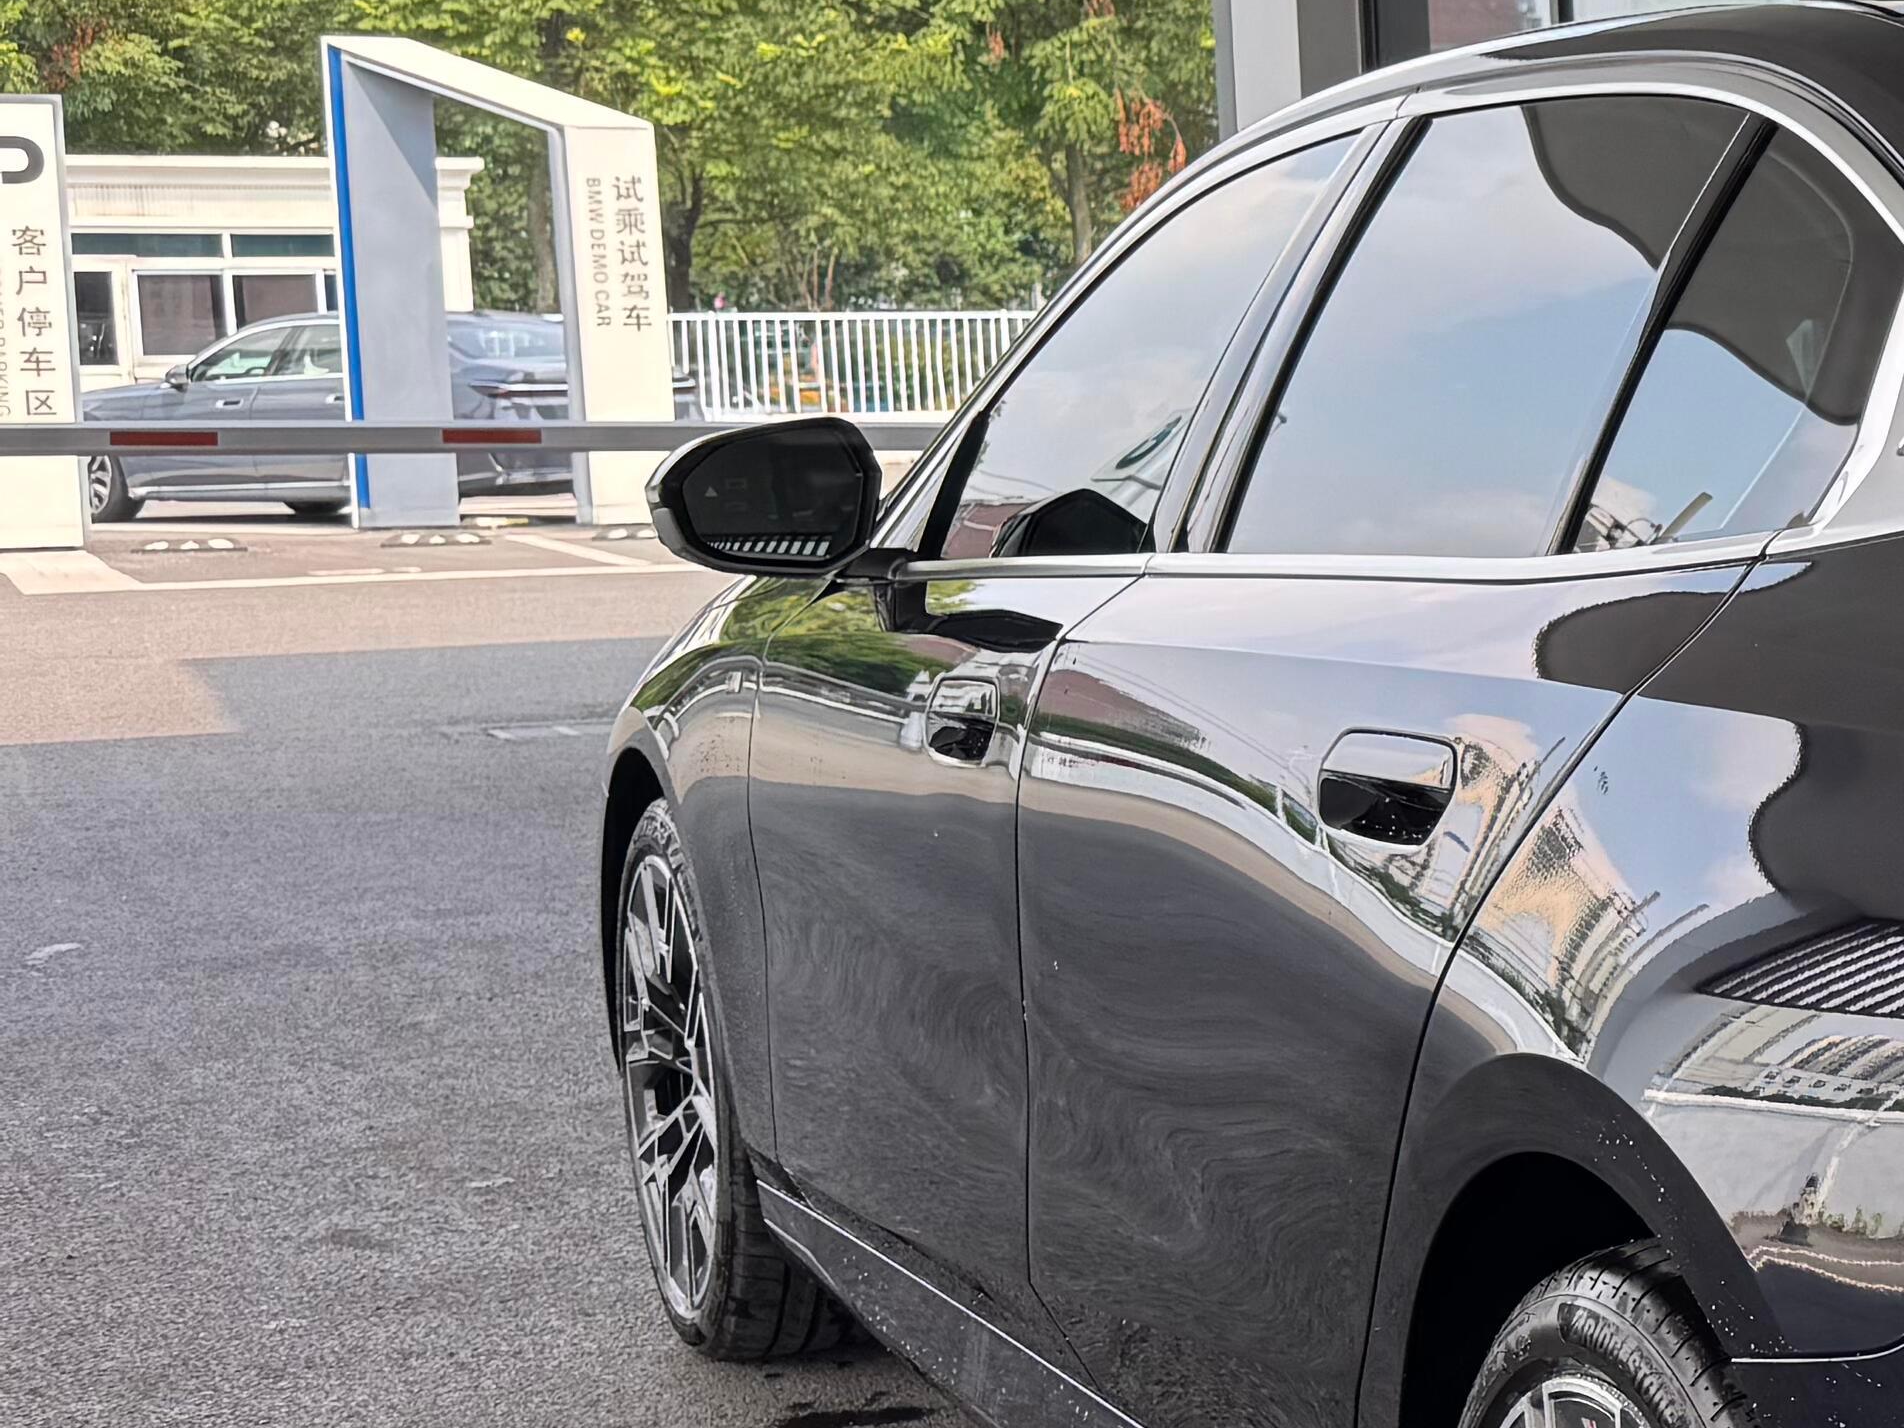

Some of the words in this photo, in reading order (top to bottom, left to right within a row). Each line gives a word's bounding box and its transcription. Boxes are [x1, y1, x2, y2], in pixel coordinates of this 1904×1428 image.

[585, 177, 605, 224] BMW
[590, 229, 609, 284] DEMO
[612, 175, 652, 332] 试乘试驾车
[11, 225, 57, 416] 客户停车区
[595, 290, 612, 327] CAR
